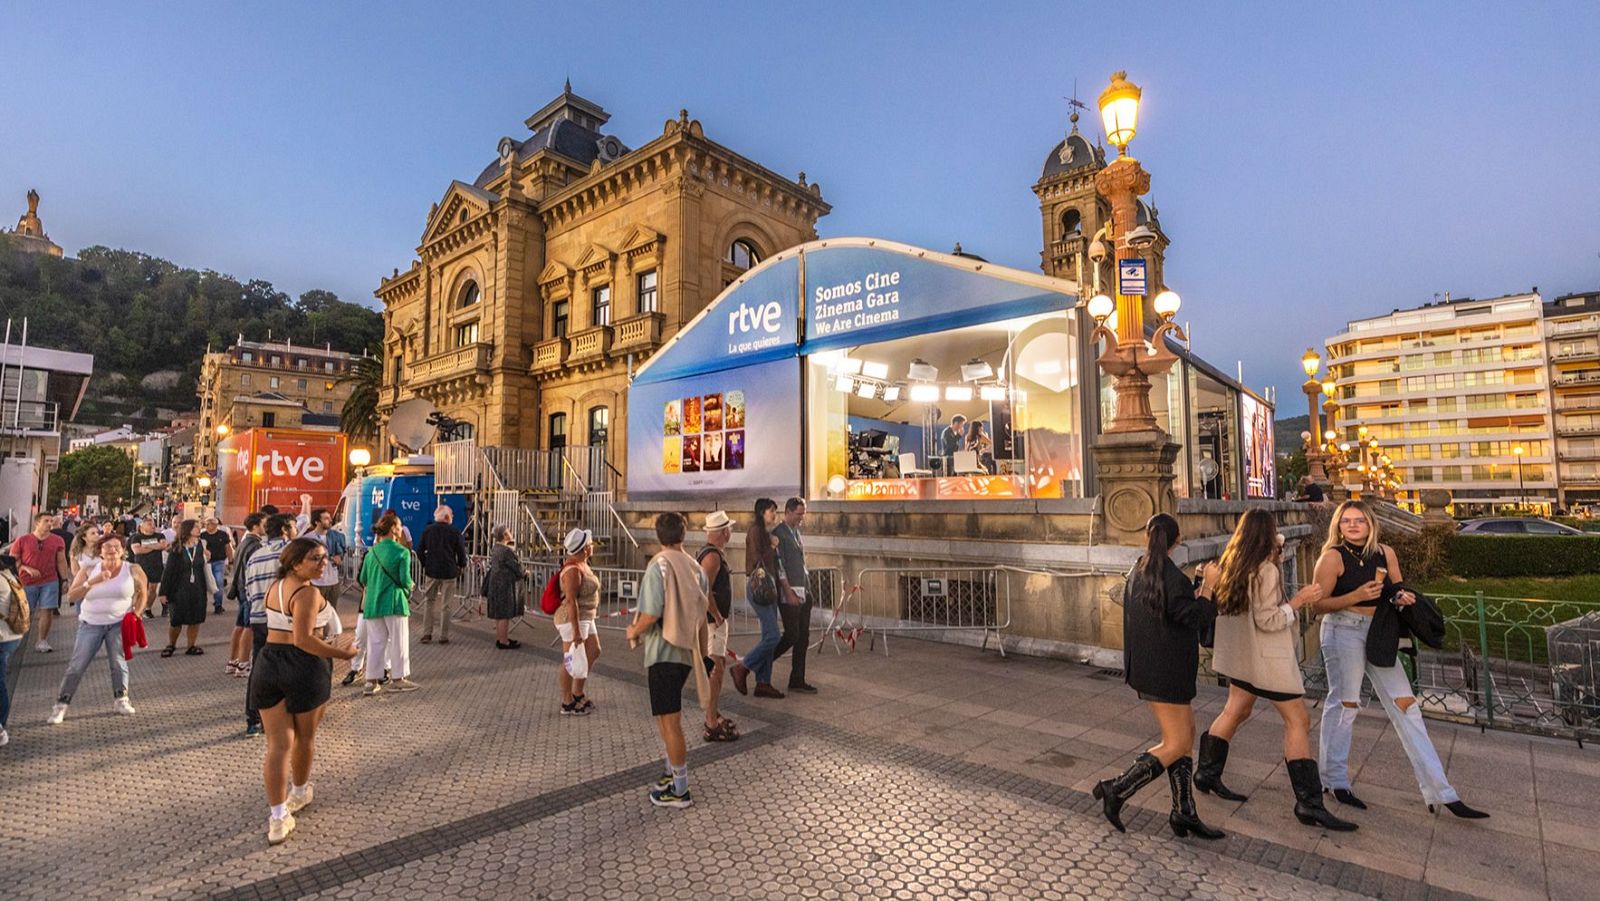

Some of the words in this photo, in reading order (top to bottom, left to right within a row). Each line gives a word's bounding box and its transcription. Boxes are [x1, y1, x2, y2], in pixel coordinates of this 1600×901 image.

[815, 280, 861, 303] Somos
[865, 271, 900, 290] Cine
[728, 301, 782, 335] rtve
[815, 299, 863, 320] Zinema
[867, 291, 899, 308] Gara
[815, 321, 831, 335] We
[832, 319, 851, 332] Are
[854, 309, 899, 327] Cinema
[728, 343, 737, 354] La
[738, 341, 752, 353] que
[753, 336, 781, 350] quieres
[256, 449, 325, 482] rtve
[371, 486, 385, 508] tve
[401, 499, 421, 511] tve
